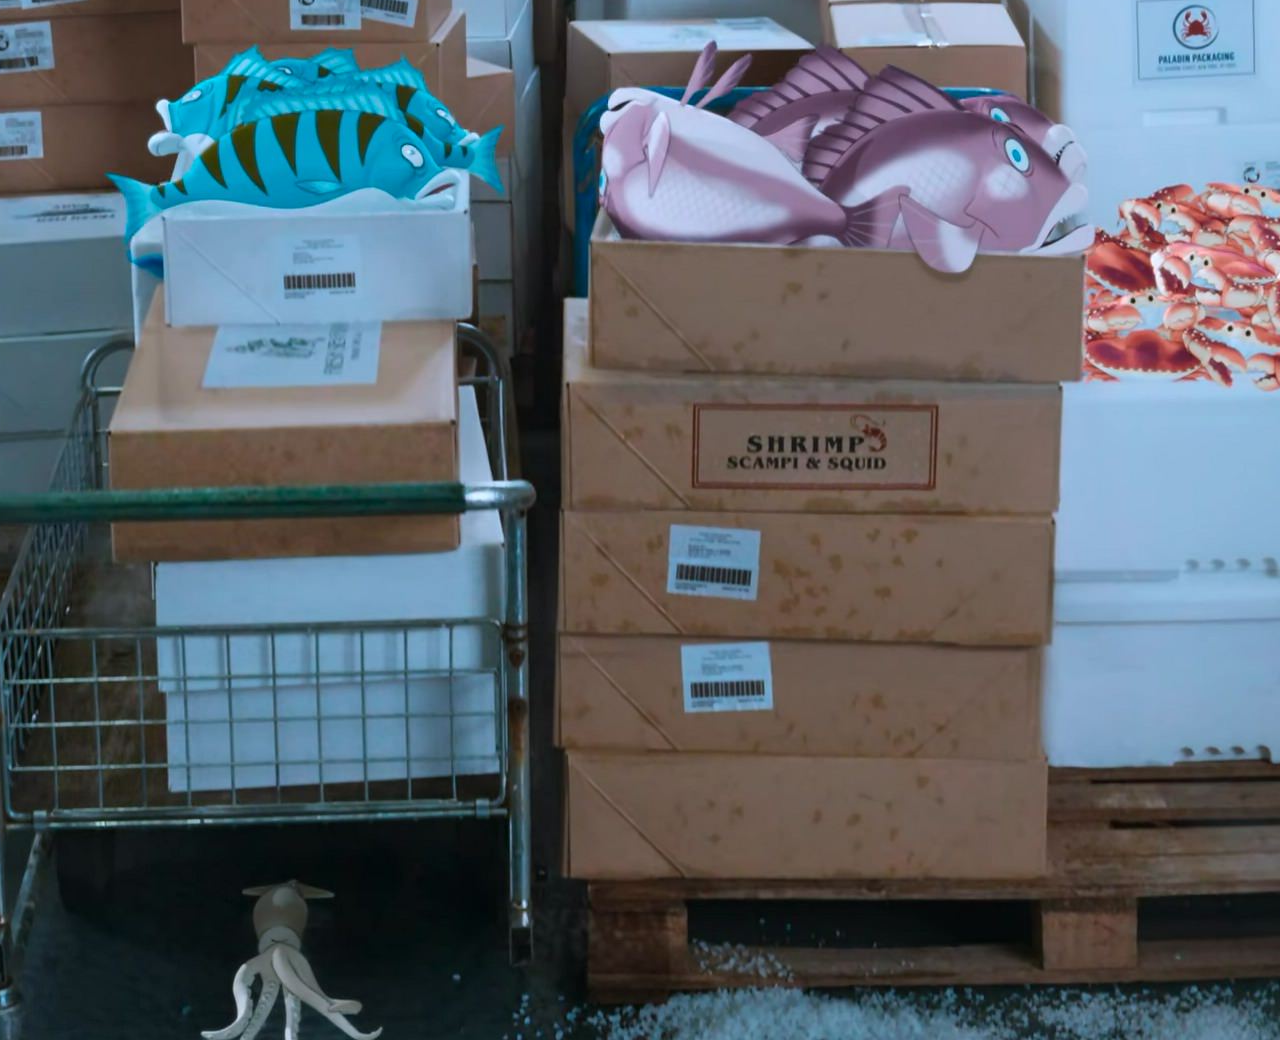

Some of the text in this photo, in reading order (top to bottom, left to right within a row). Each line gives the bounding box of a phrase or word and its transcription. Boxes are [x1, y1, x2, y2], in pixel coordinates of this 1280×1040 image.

[1158, 51, 1235, 64] PALADIN PACKAGING
[746, 435, 865, 453] SHRIMP
[727, 457, 887, 471] SCAMPI & SQUID
